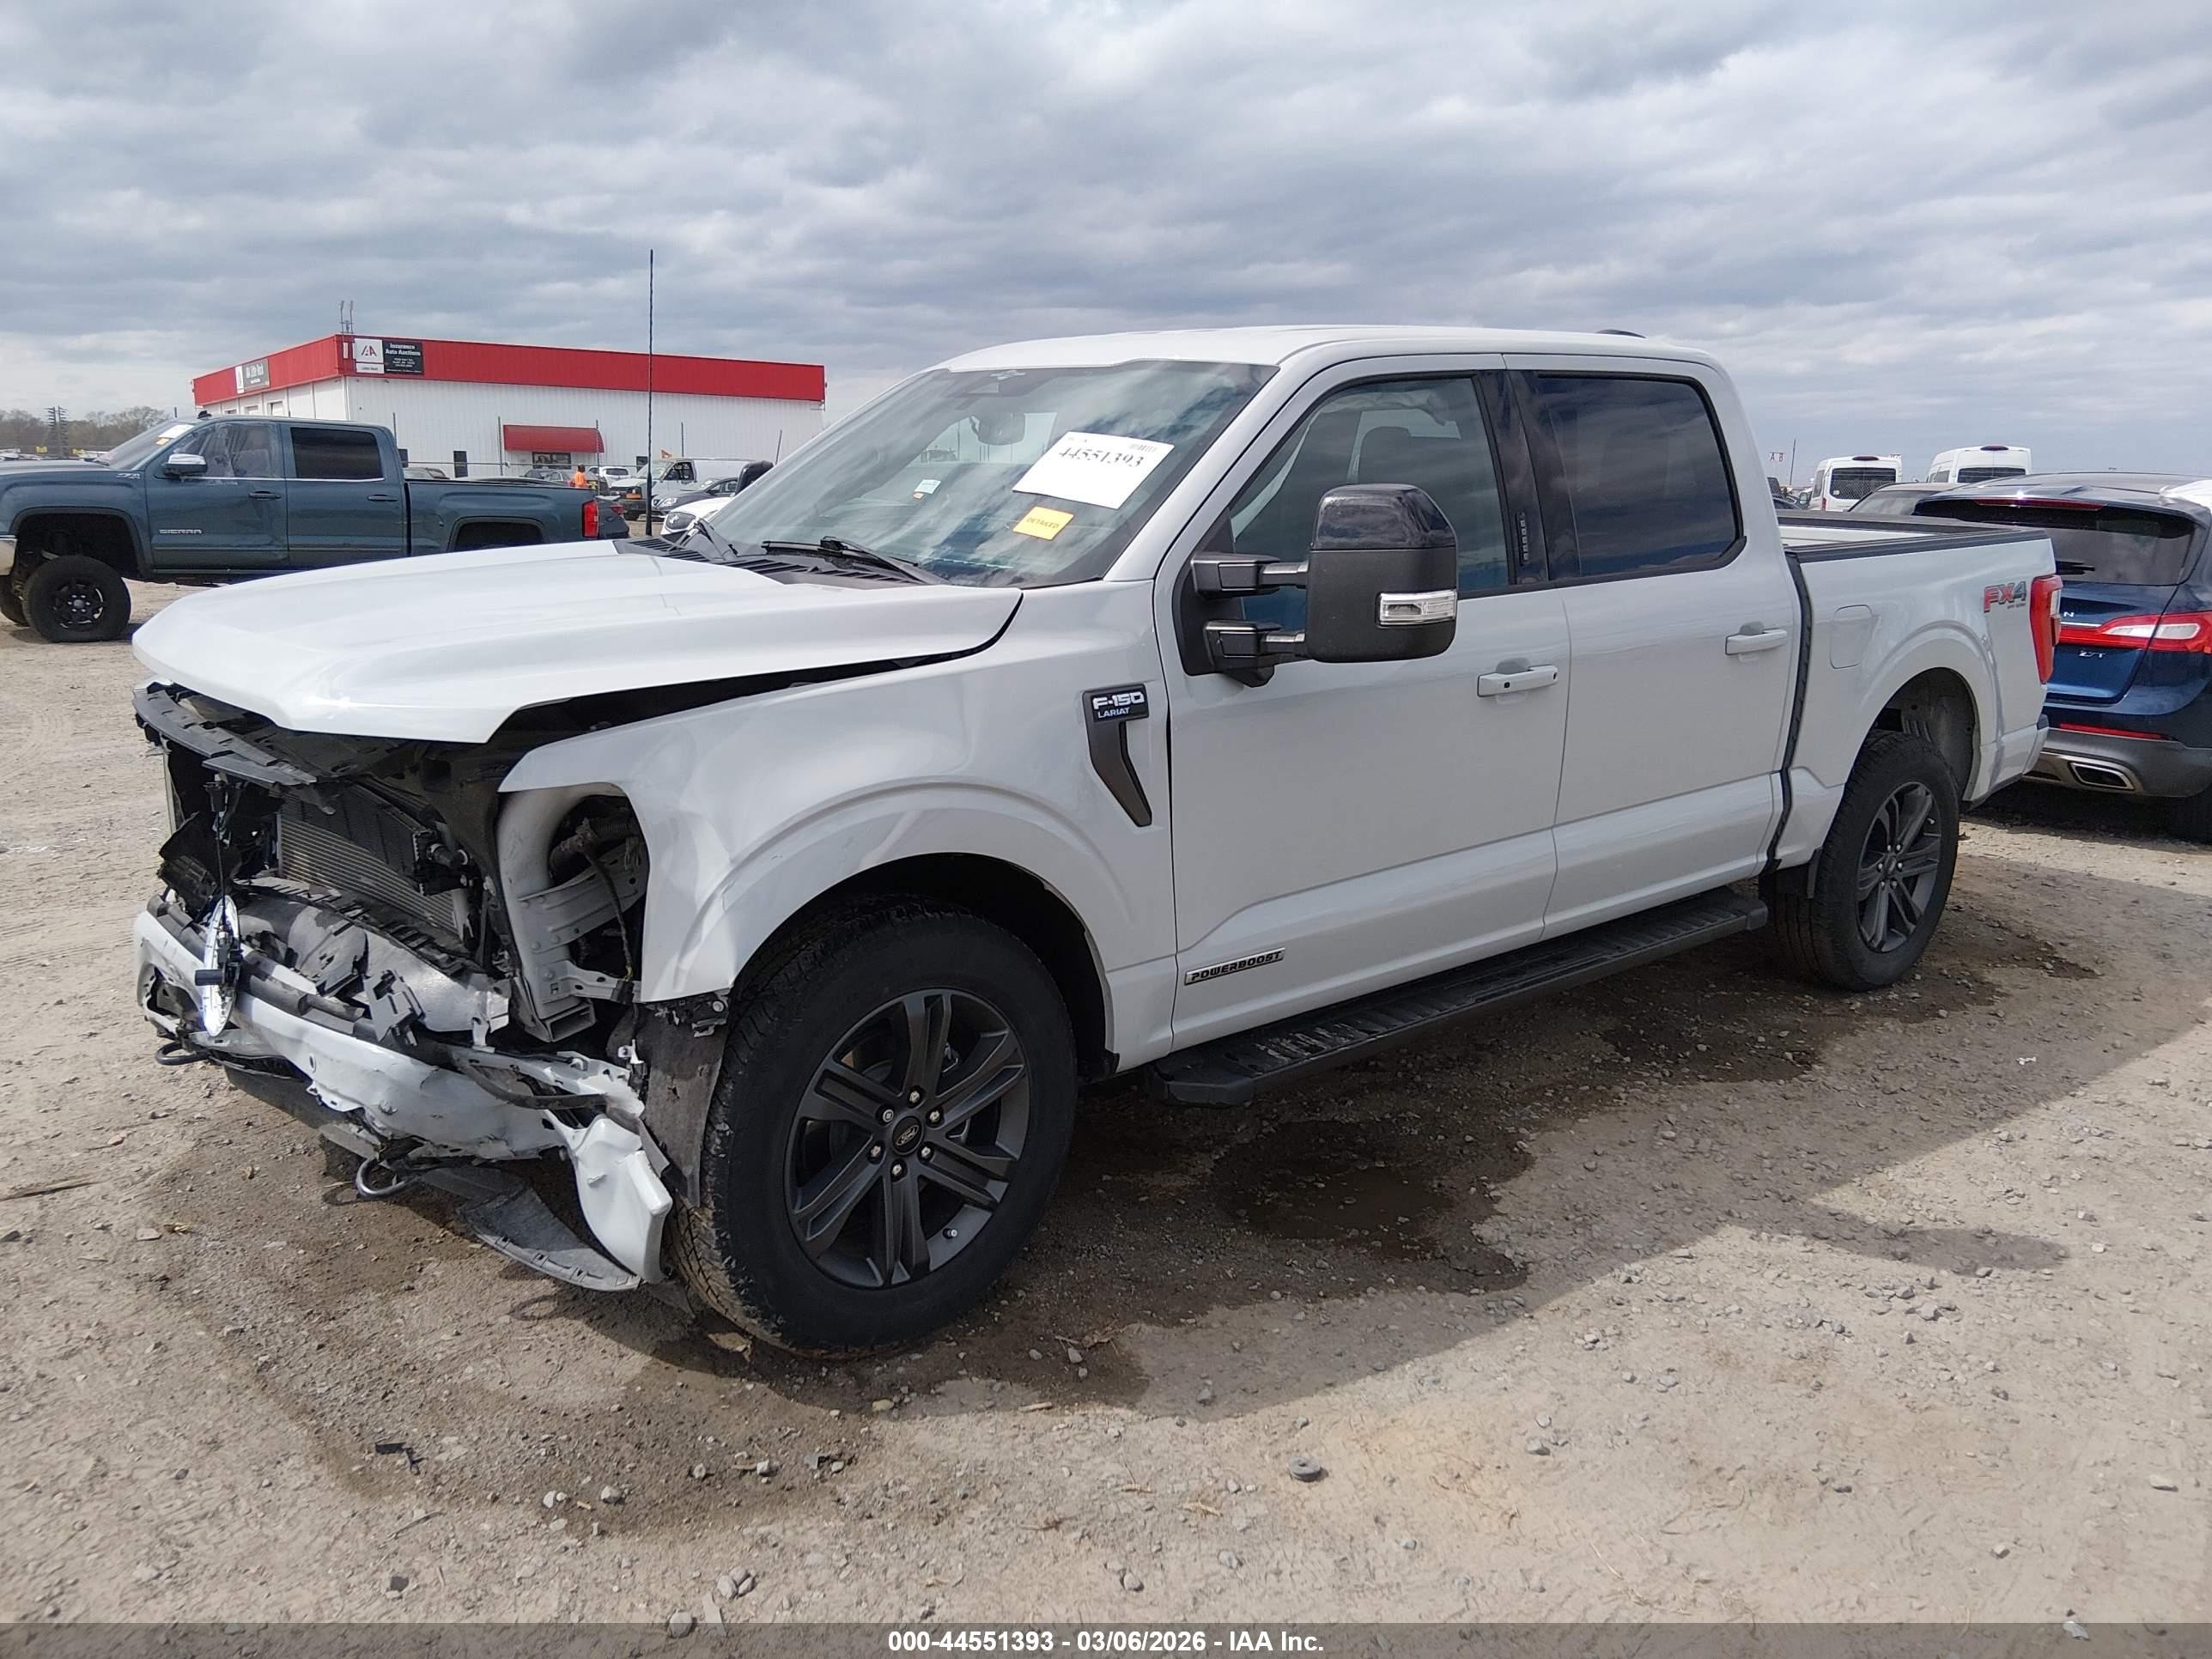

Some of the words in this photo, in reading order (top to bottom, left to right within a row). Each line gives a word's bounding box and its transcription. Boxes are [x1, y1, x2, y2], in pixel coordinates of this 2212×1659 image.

[1059, 447, 1145, 468] 44551393
[1983, 580, 2027, 613] FX4
[1092, 691, 1146, 710] F-150
[1097, 706, 1131, 719] LARIAT
[1190, 950, 1283, 981] POWERBOOST
